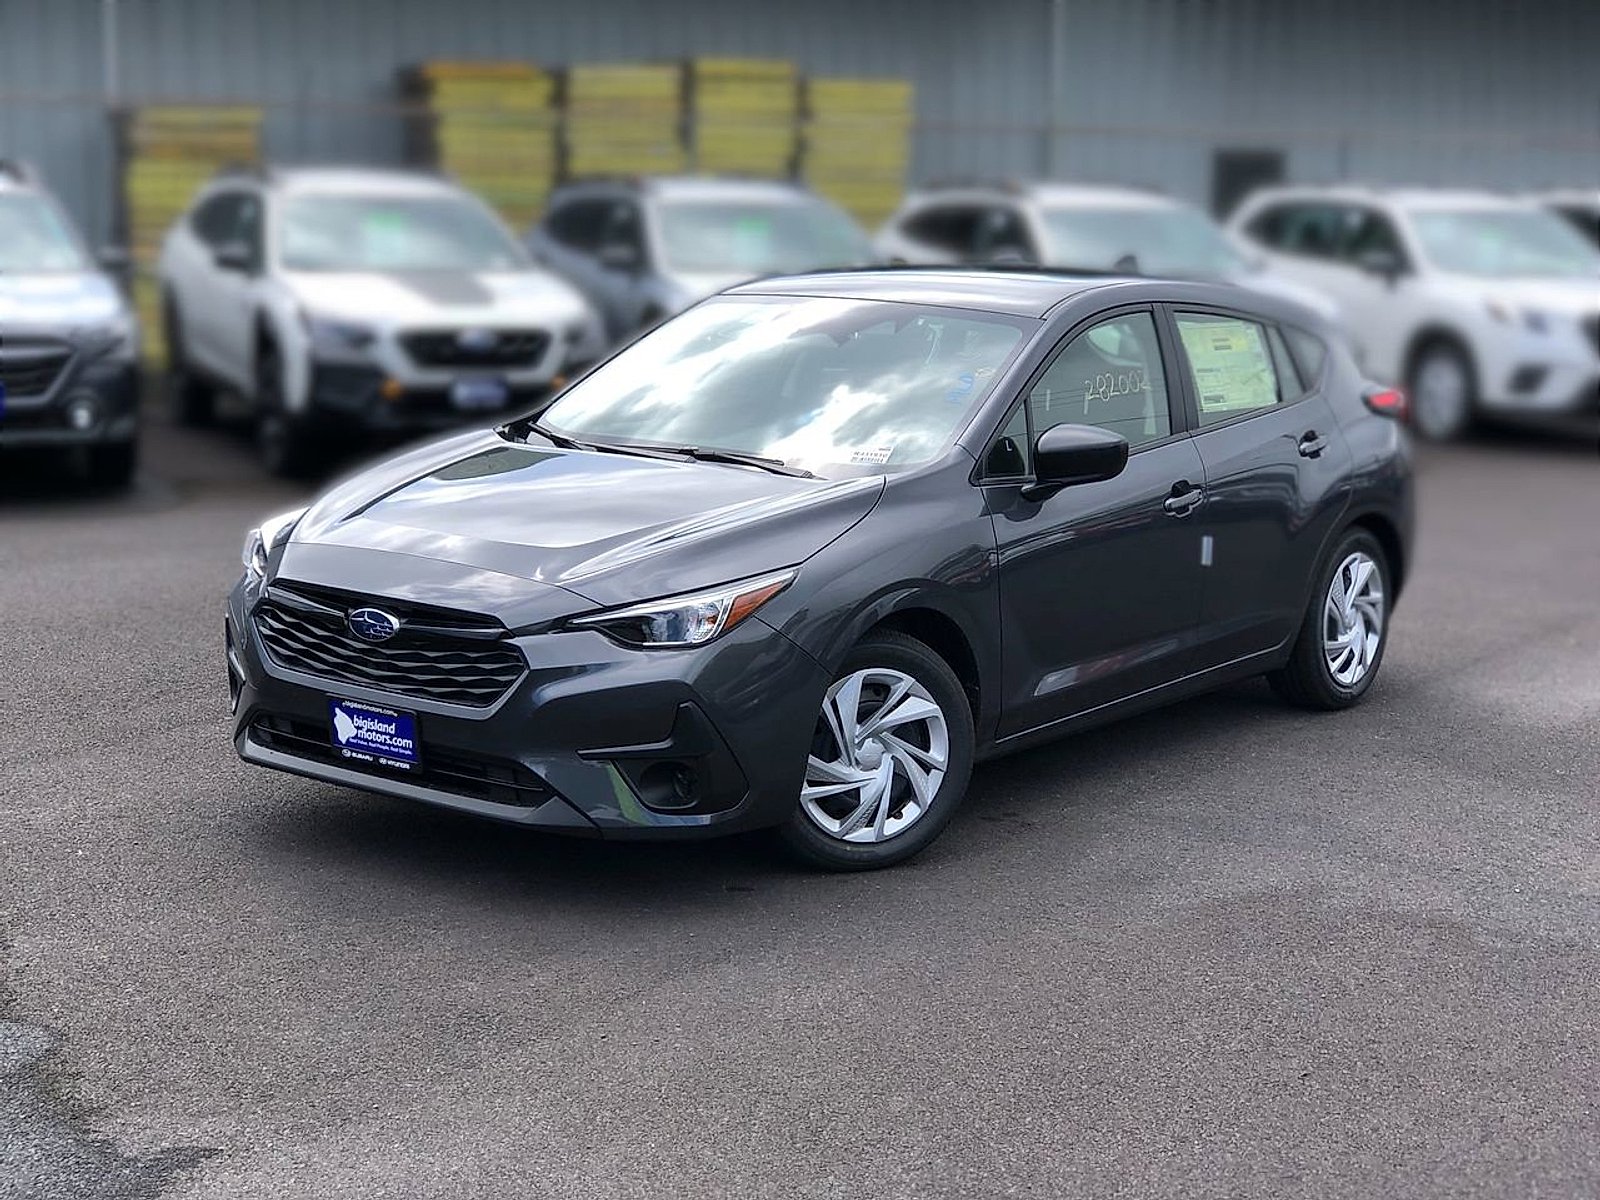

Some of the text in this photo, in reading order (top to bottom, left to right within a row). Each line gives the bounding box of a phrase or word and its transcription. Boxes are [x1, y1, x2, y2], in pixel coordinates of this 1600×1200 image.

[353, 714, 396, 735] bigisland
[357, 729, 413, 749] motors.com
[352, 752, 373, 761] SUBARU
